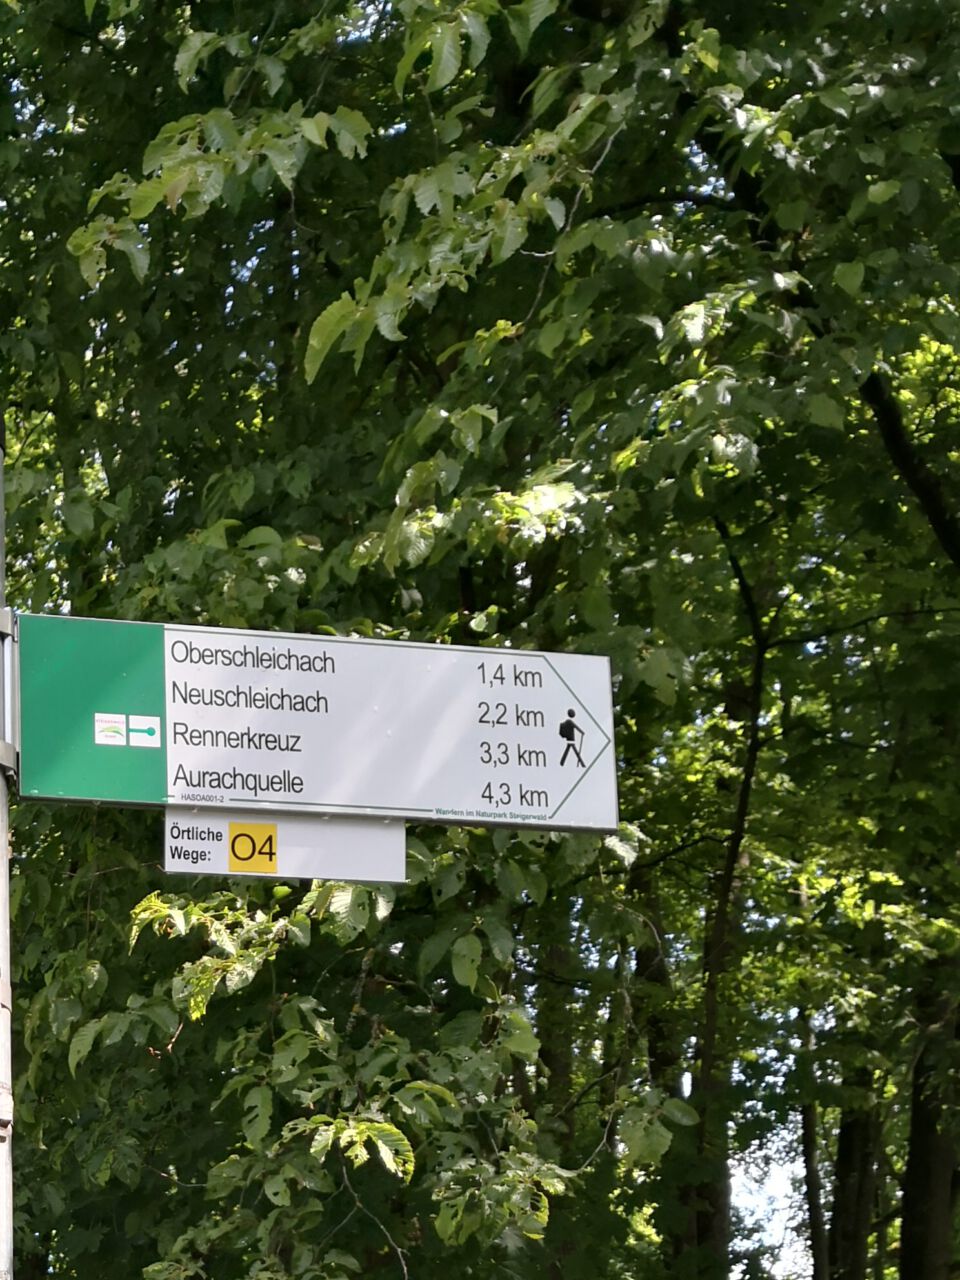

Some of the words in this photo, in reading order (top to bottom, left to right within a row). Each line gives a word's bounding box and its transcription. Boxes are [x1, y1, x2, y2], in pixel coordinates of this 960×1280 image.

[171, 640, 335, 674] Oberschleichach
[477, 662, 506, 687] 1,4
[513, 665, 543, 689] km
[171, 681, 328, 713] Neuschleichach
[478, 702, 508, 726] 2,2
[515, 704, 544, 727] km
[172, 722, 301, 752] Rennerkreuz
[480, 741, 510, 767] 3,3
[517, 743, 546, 767] km
[172, 763, 304, 798] Aurachquelle
[481, 782, 512, 807] 4,3
[519, 784, 548, 808] km
[476, 810, 507, 819] Naturpark
[171, 823, 223, 843] Örtliche
[170, 845, 211, 863] Wege:
